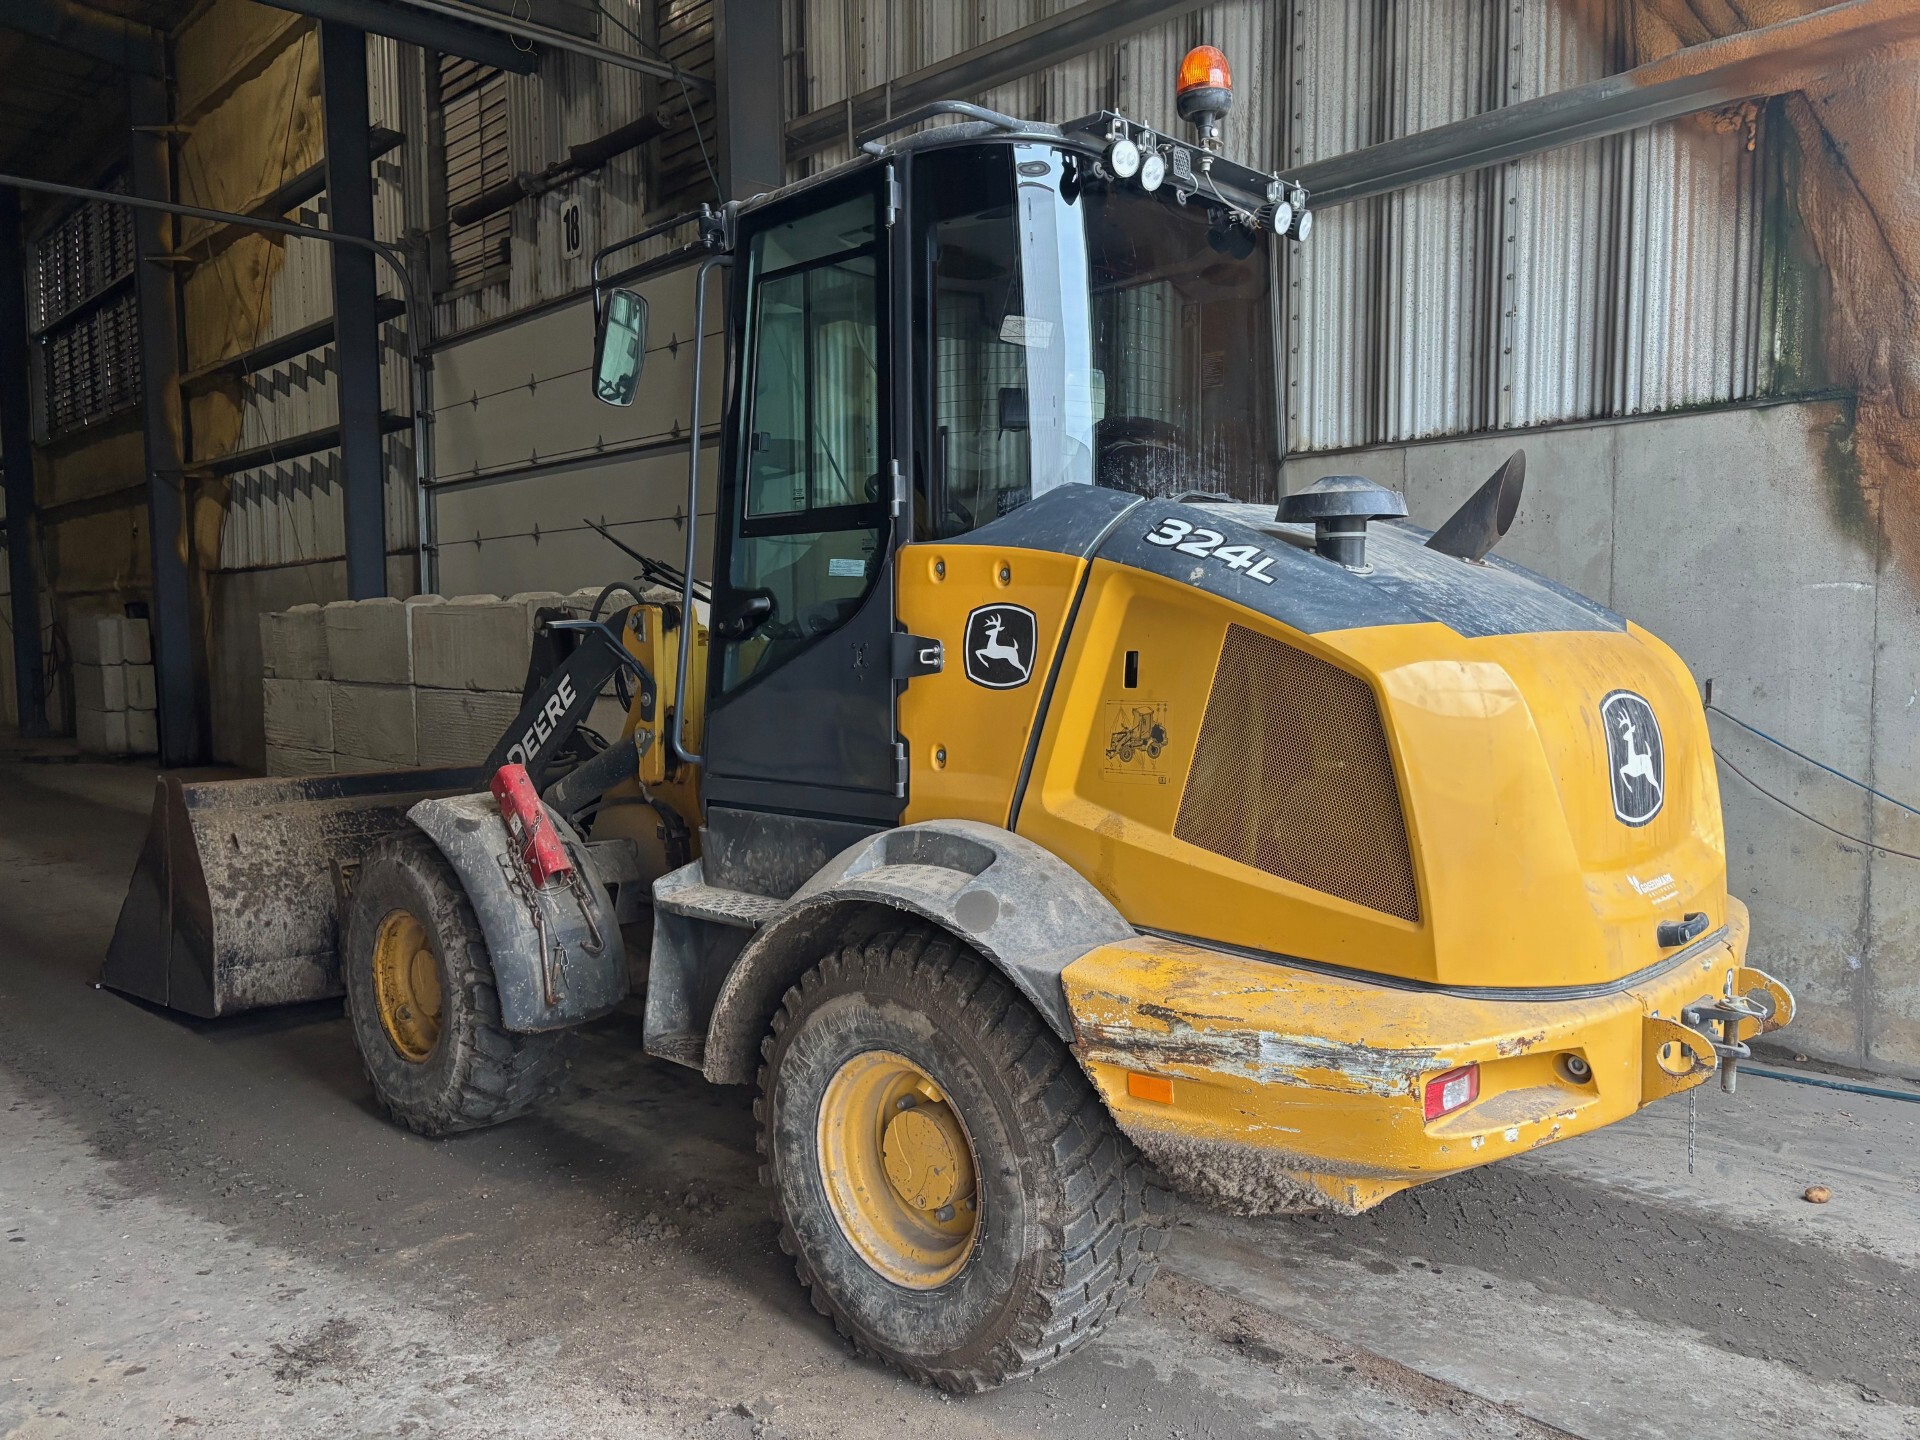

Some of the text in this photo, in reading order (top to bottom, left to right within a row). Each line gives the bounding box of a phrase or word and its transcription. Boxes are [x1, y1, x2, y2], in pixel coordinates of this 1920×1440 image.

[564, 205, 579, 252] 18
[1142, 517, 1278, 586] 324L
[506, 673, 577, 768] DEERE
